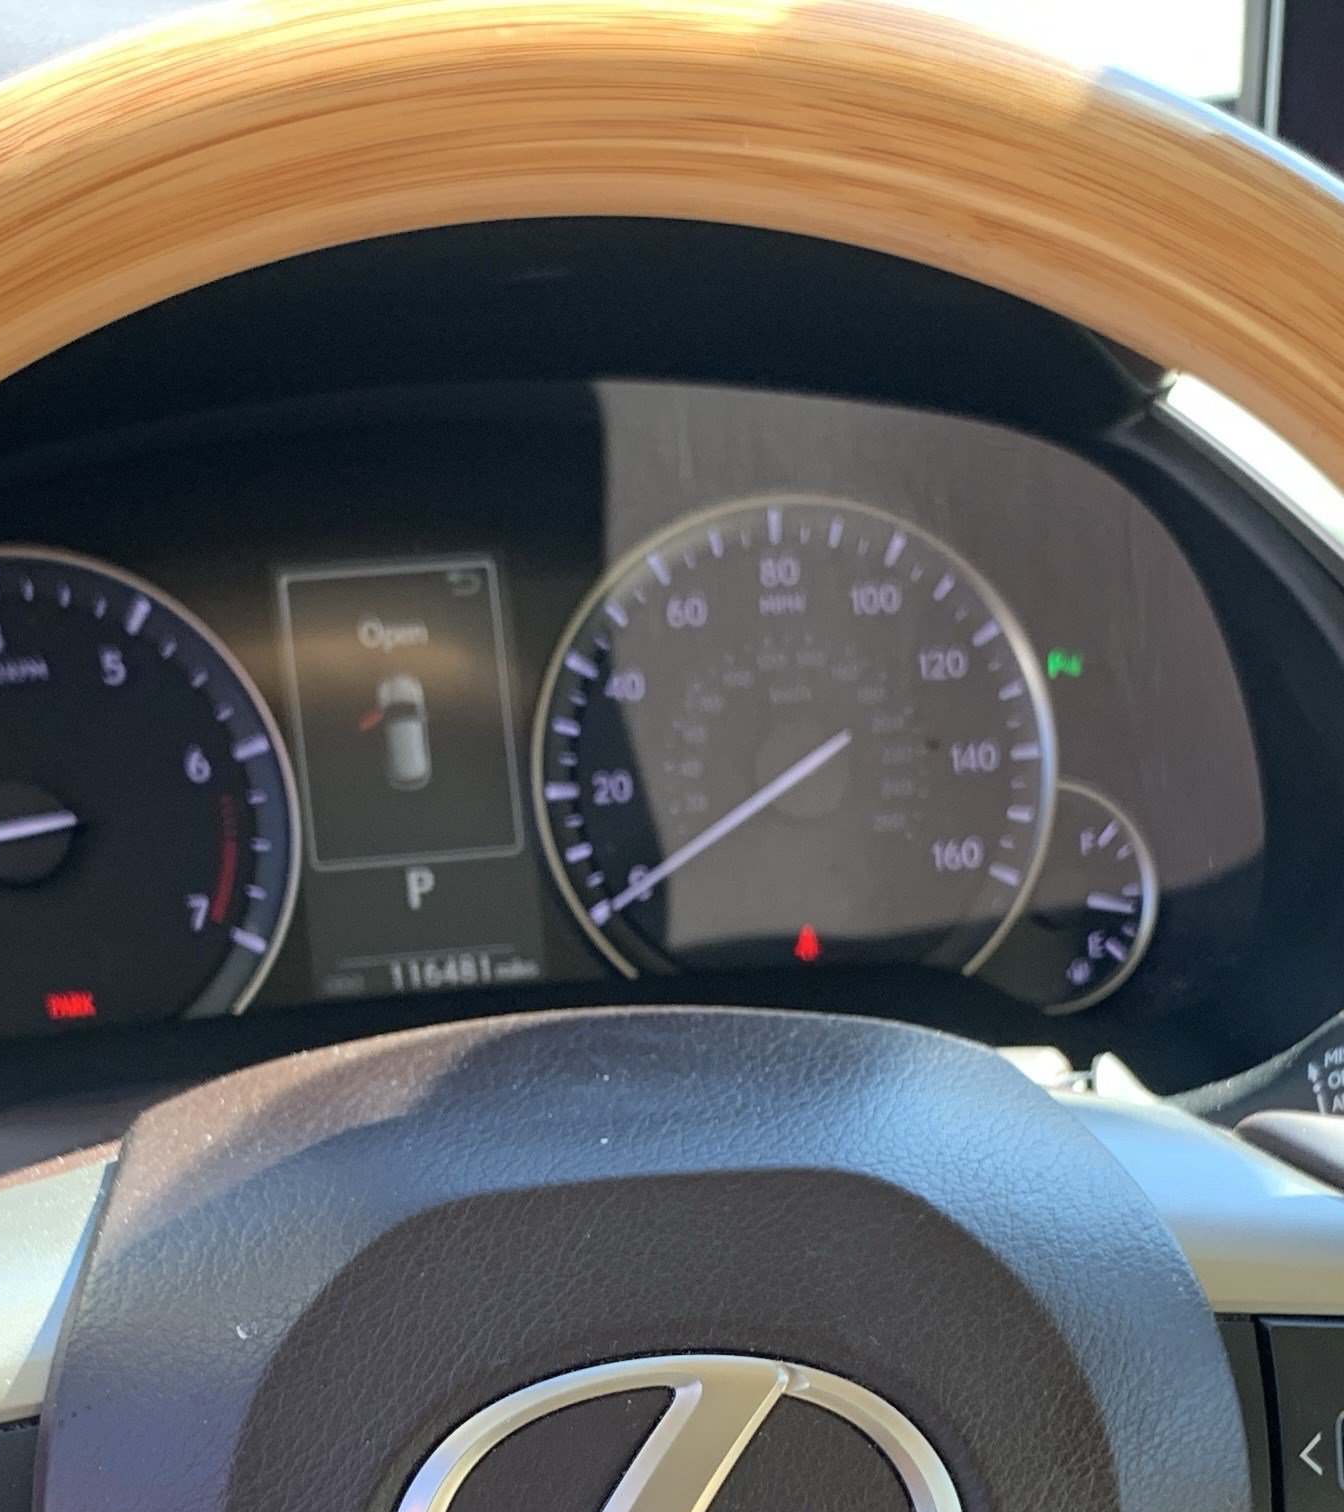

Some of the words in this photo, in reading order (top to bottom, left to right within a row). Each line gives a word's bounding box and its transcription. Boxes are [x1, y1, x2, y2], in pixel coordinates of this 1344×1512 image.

[759, 558, 801, 588] 80
[666, 597, 708, 629] 60
[851, 583, 902, 616] 100
[357, 618, 429, 652] Open
[100, 645, 127, 686] 5
[918, 649, 968, 681] 120
[604, 670, 646, 701] 40
[183, 745, 212, 783] 6
[949, 741, 1000, 772] 140
[591, 771, 634, 805] 20
[931, 836, 982, 870] 160
[406, 866, 436, 911] P
[186, 894, 209, 932] 7
[1087, 930, 1106, 960] E
[390, 952, 492, 992] 116481
